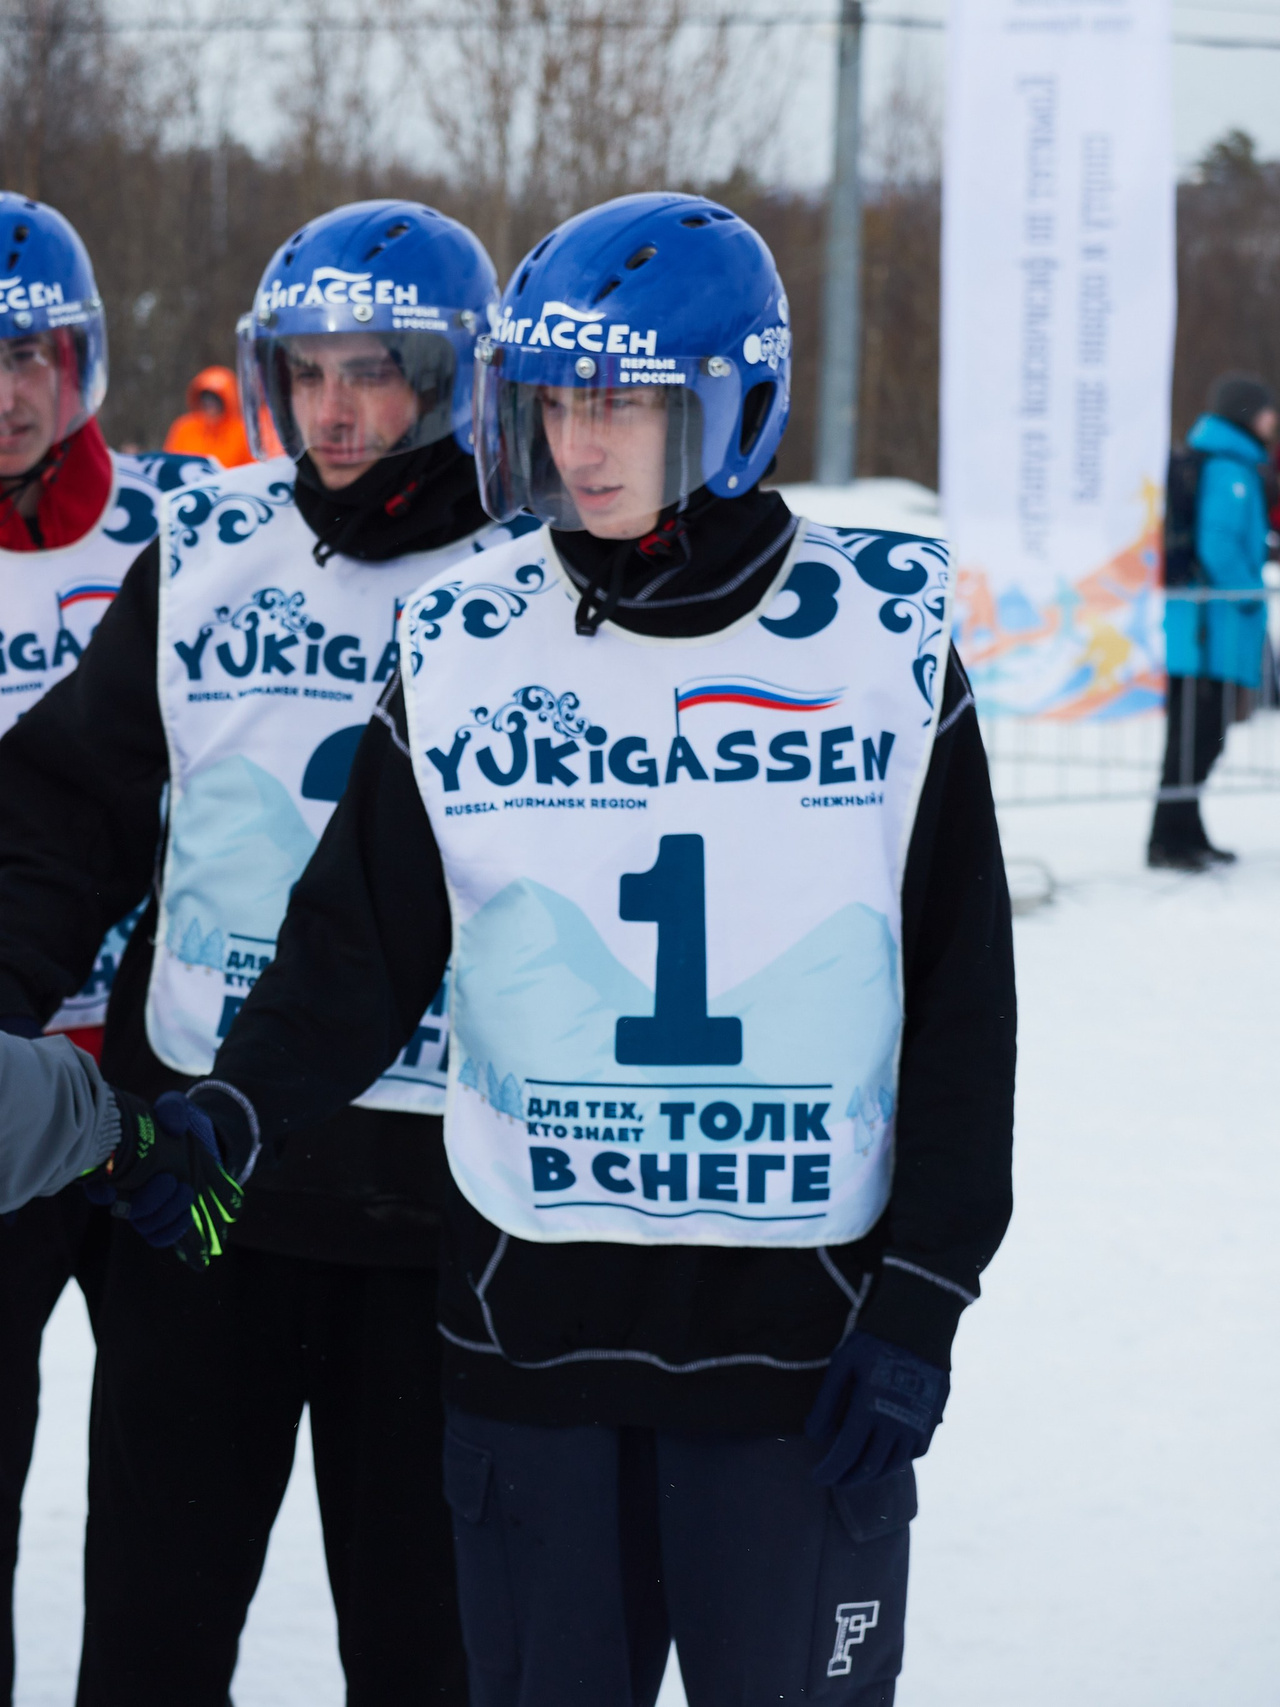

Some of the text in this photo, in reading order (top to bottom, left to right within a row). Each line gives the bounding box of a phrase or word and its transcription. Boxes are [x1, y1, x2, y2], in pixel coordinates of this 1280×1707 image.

[620, 372, 685, 384] В РОССИИ
[621, 358, 676, 370] ПЕРВЫЕ
[174, 611, 401, 682] YUKiGA
[590, 799, 647, 809] REGION
[615, 833, 743, 1066] 1
[528, 1097, 643, 1122] ДЛЯ ТЕХ,
[659, 1101, 832, 1142] ТОЛК
[528, 1122, 644, 1142] КТО ЗНАЕТ
[529, 1146, 832, 1204] В СНЕГЕ
[826, 1600, 881, 1677] F
